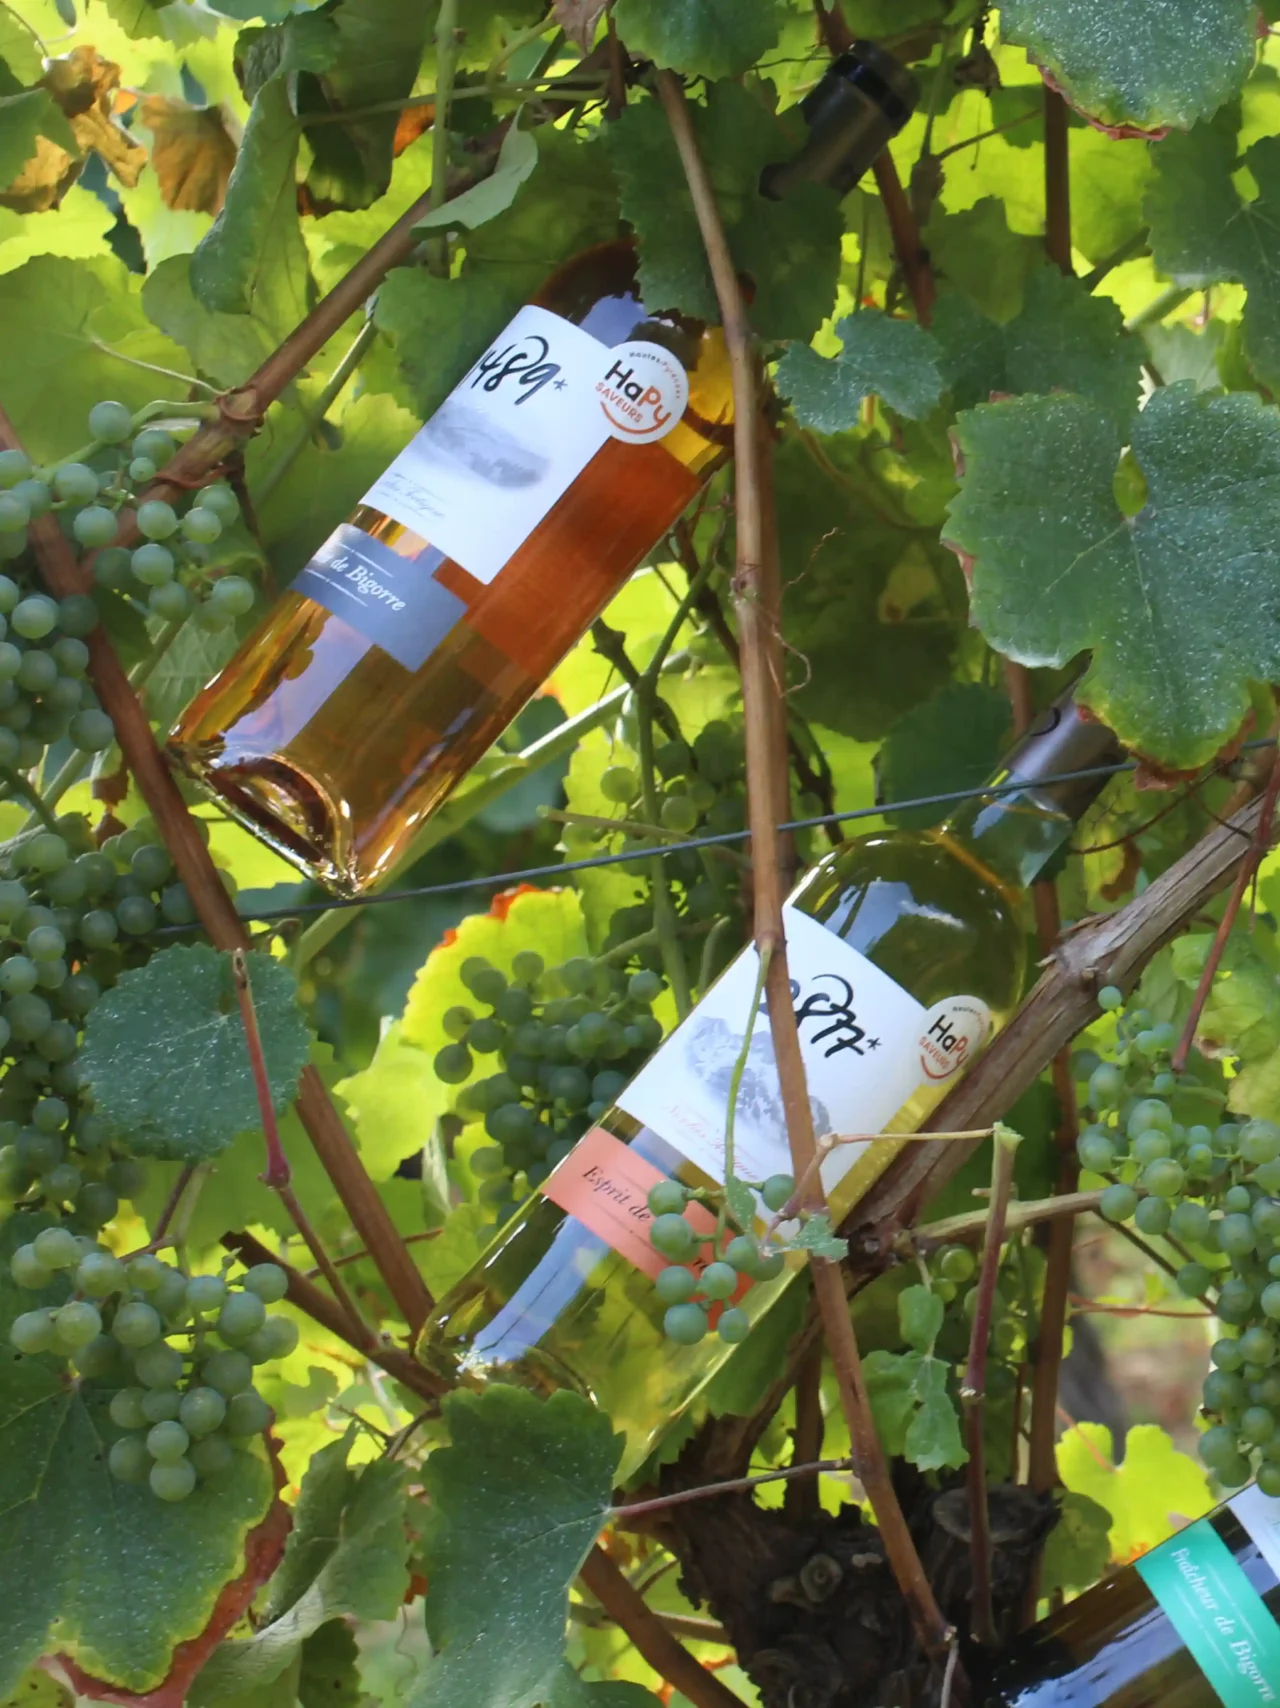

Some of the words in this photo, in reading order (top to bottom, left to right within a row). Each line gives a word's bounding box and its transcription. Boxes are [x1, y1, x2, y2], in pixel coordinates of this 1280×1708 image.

[595, 382, 643, 423] SAVEURS
[604, 359, 672, 426] HaPy
[330, 556, 349, 572] de
[345, 565, 406, 611] Bigorre
[583, 1166, 632, 1204] Esprit
[628, 1204, 651, 1221] de
[1214, 1616, 1235, 1635] de
[1229, 1640, 1276, 1702] Bigorre
